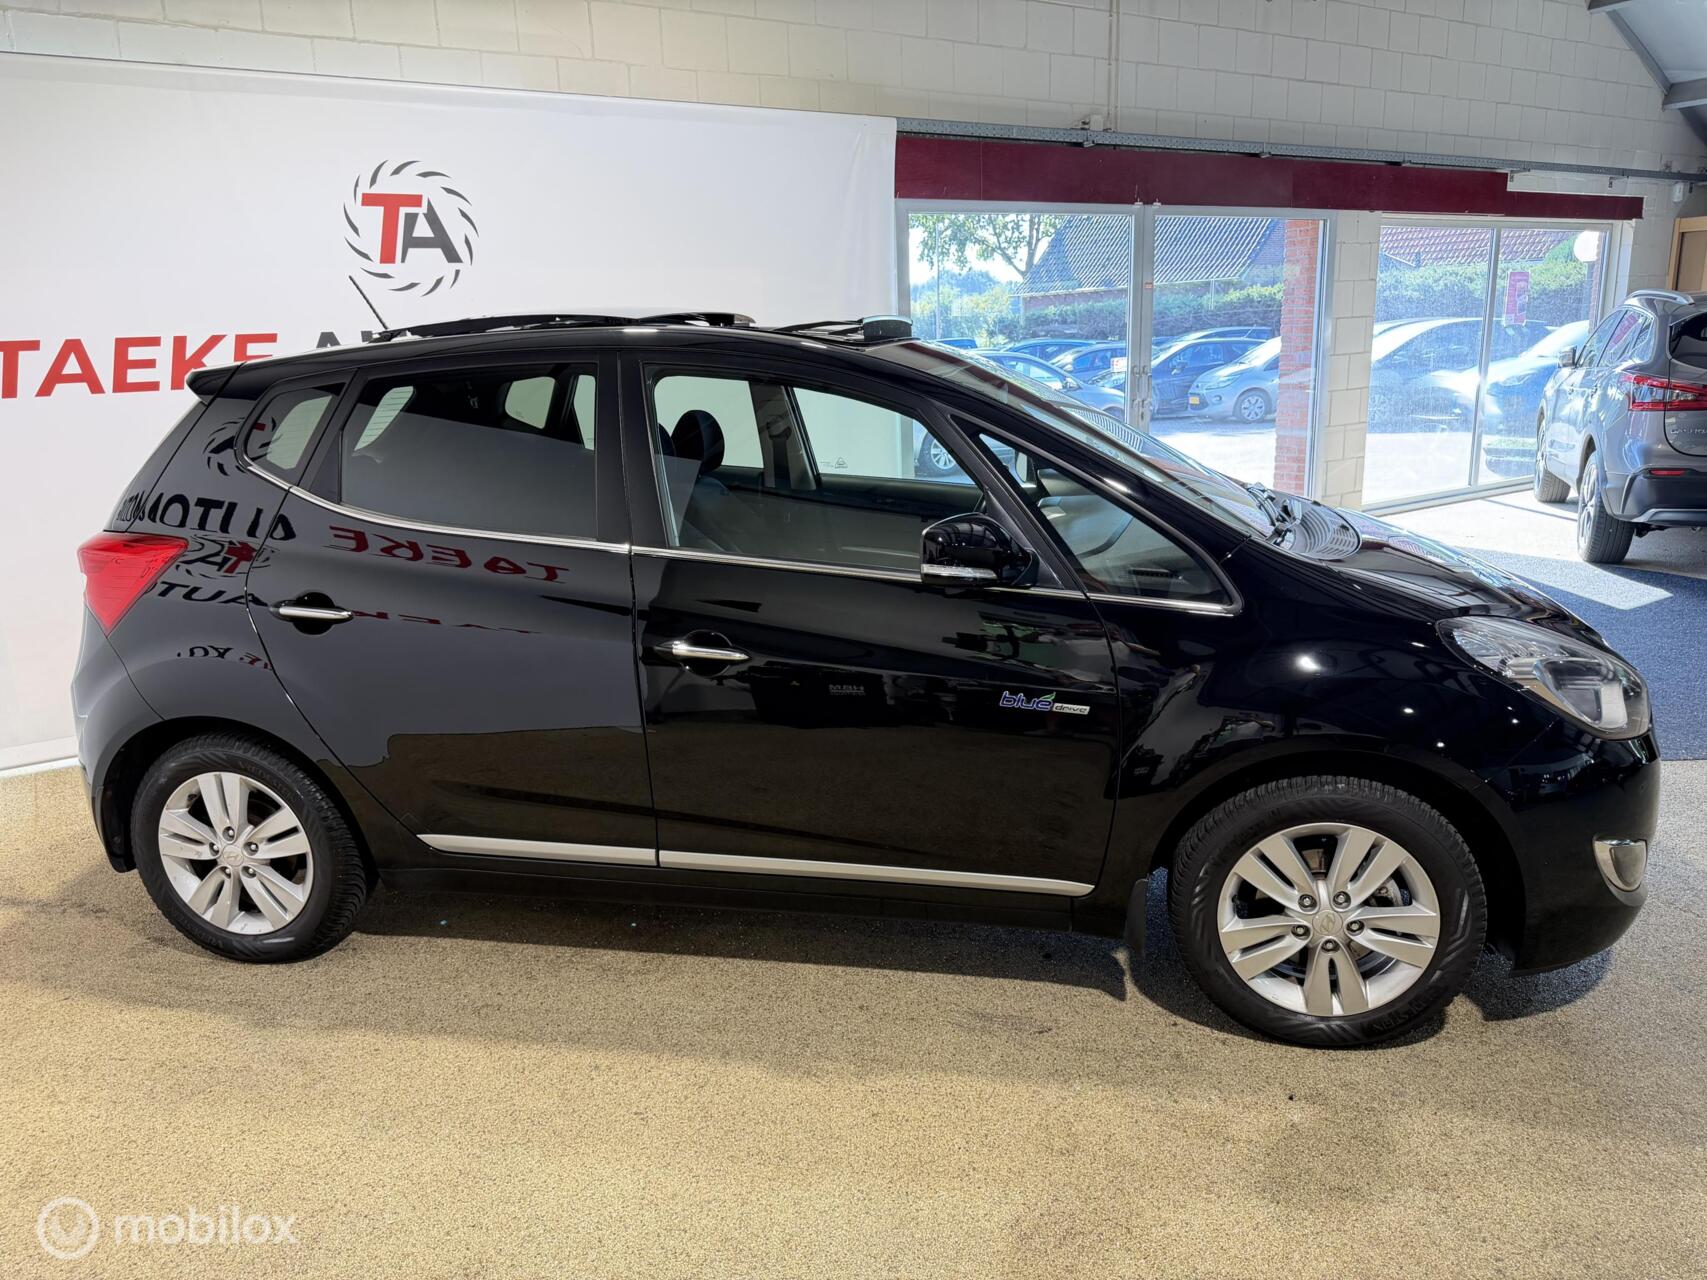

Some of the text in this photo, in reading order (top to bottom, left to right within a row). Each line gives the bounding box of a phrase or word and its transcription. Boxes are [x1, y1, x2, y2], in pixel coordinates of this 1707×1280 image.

[360, 192, 463, 265] TA
[1000, 691, 1088, 714] blue drive
